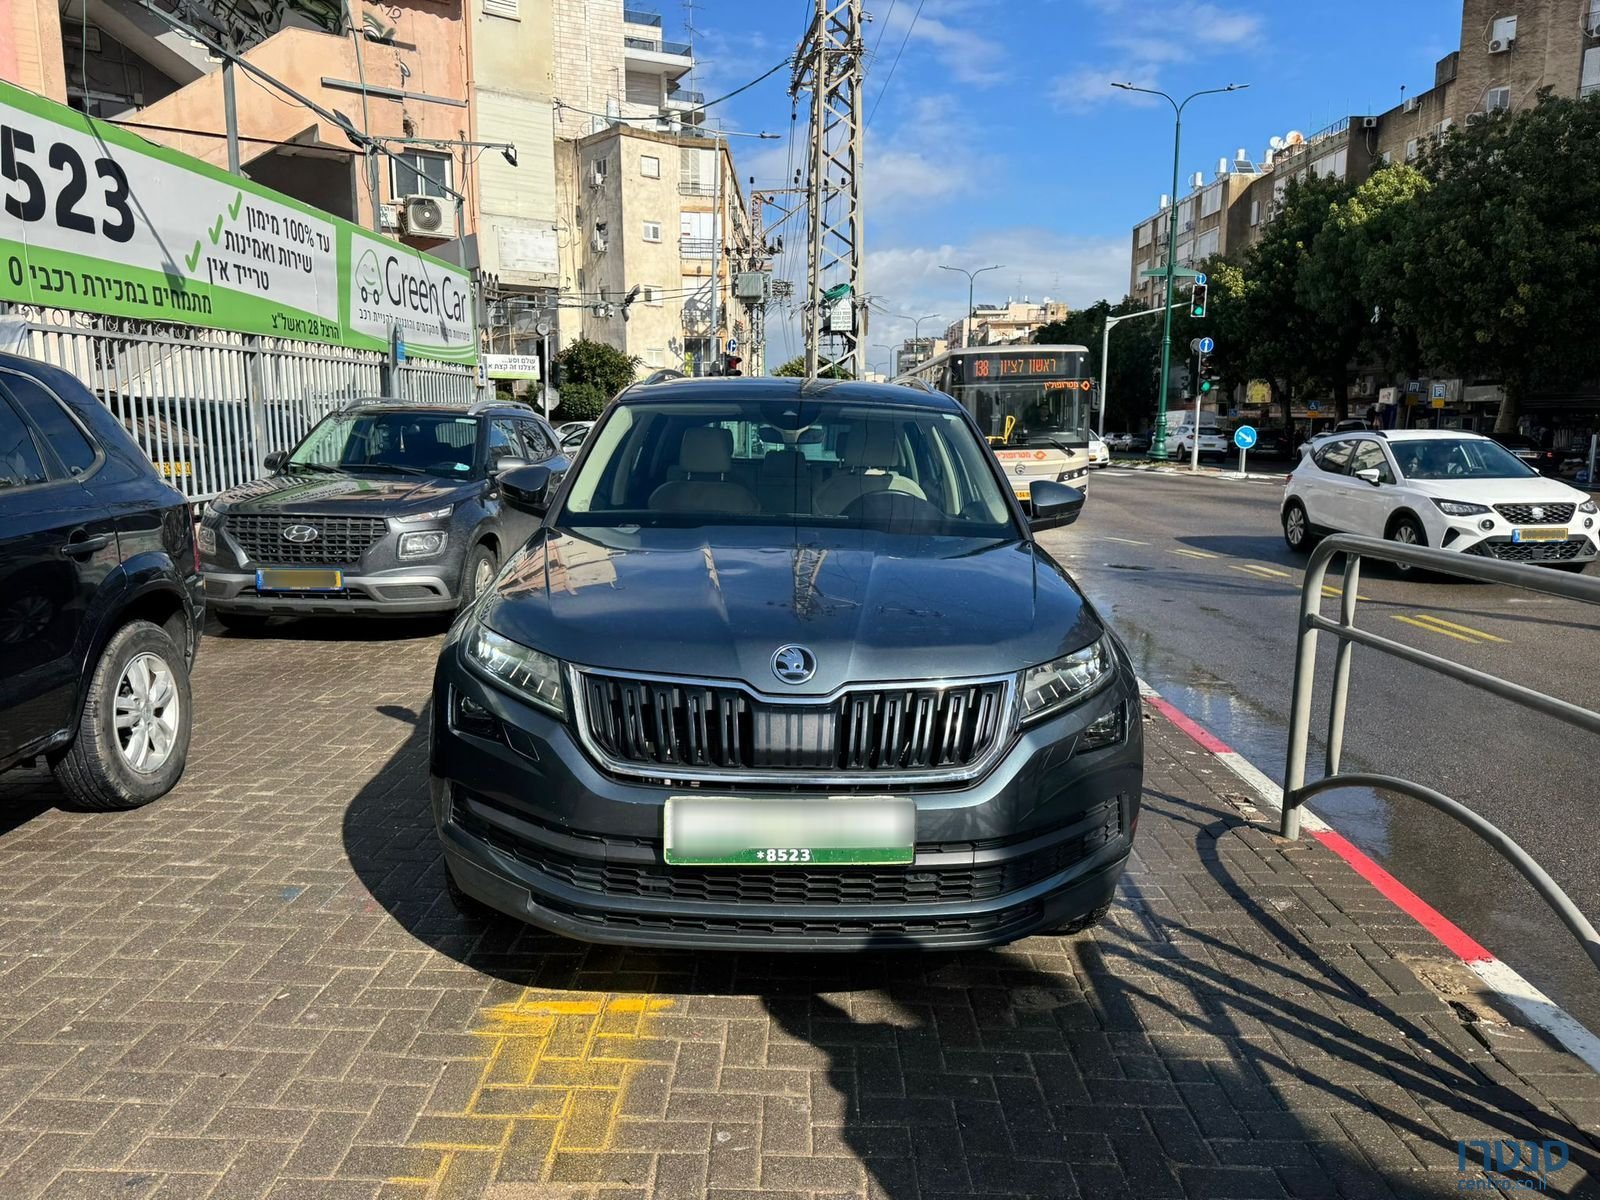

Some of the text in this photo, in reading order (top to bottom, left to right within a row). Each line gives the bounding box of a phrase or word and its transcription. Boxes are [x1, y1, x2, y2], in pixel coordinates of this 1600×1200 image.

[1, 124, 135, 243] 523
[246, 206, 330, 253] עד 100% מימון
[224, 230, 312, 274] שירות ואמינות
[8, 255, 212, 314] מתמחים במכירת רכבי 0
[206, 256, 270, 291] טרייד אין
[385, 255, 467, 323] Green Car
[307, 318, 319, 334] 28
[319, 319, 339, 339] הרצל
[358, 308, 372, 320] רכב
[974, 359, 989, 377] 138
[1000, 358, 1056, 375] ראשון לציון
